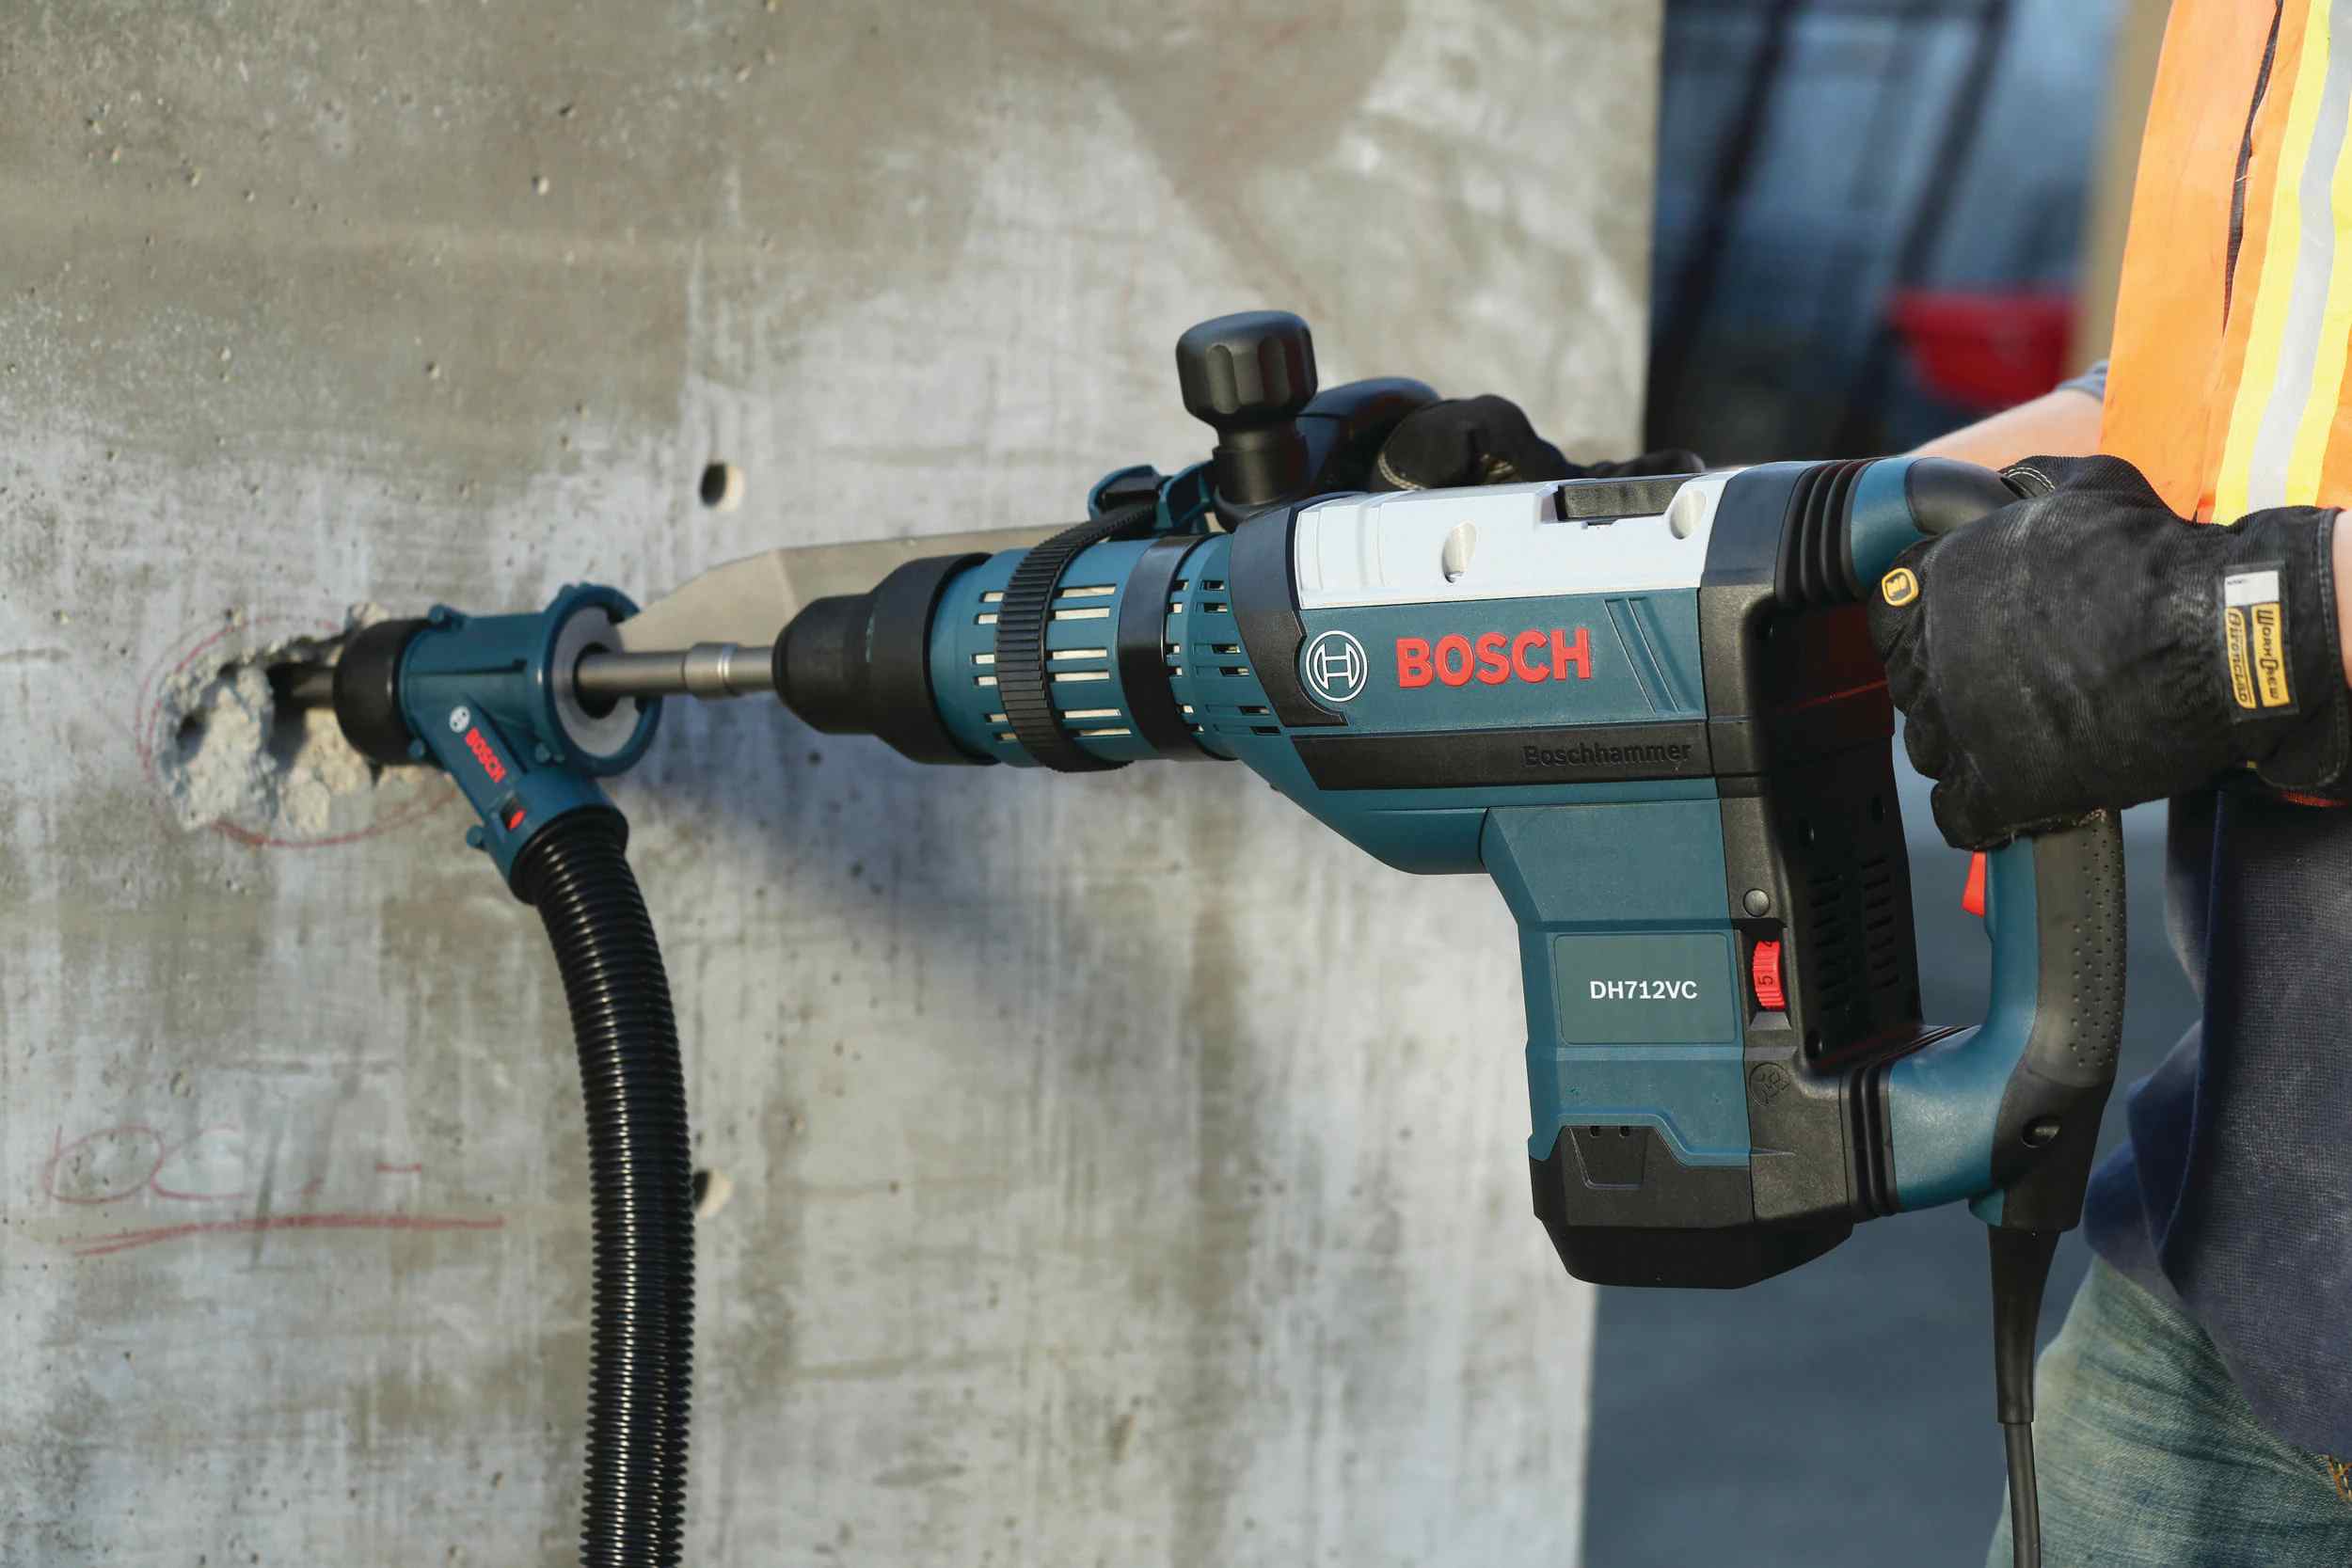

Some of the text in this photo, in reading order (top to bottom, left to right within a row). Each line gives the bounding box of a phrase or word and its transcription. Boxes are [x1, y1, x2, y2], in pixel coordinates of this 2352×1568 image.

[1395, 627, 1592, 689] BOSCH
[465, 726, 507, 783] BOSCH
[1522, 741, 1692, 768] Boschhammer
[1589, 980, 1698, 1000] DH712VC
[1757, 975, 1773, 986] 5
